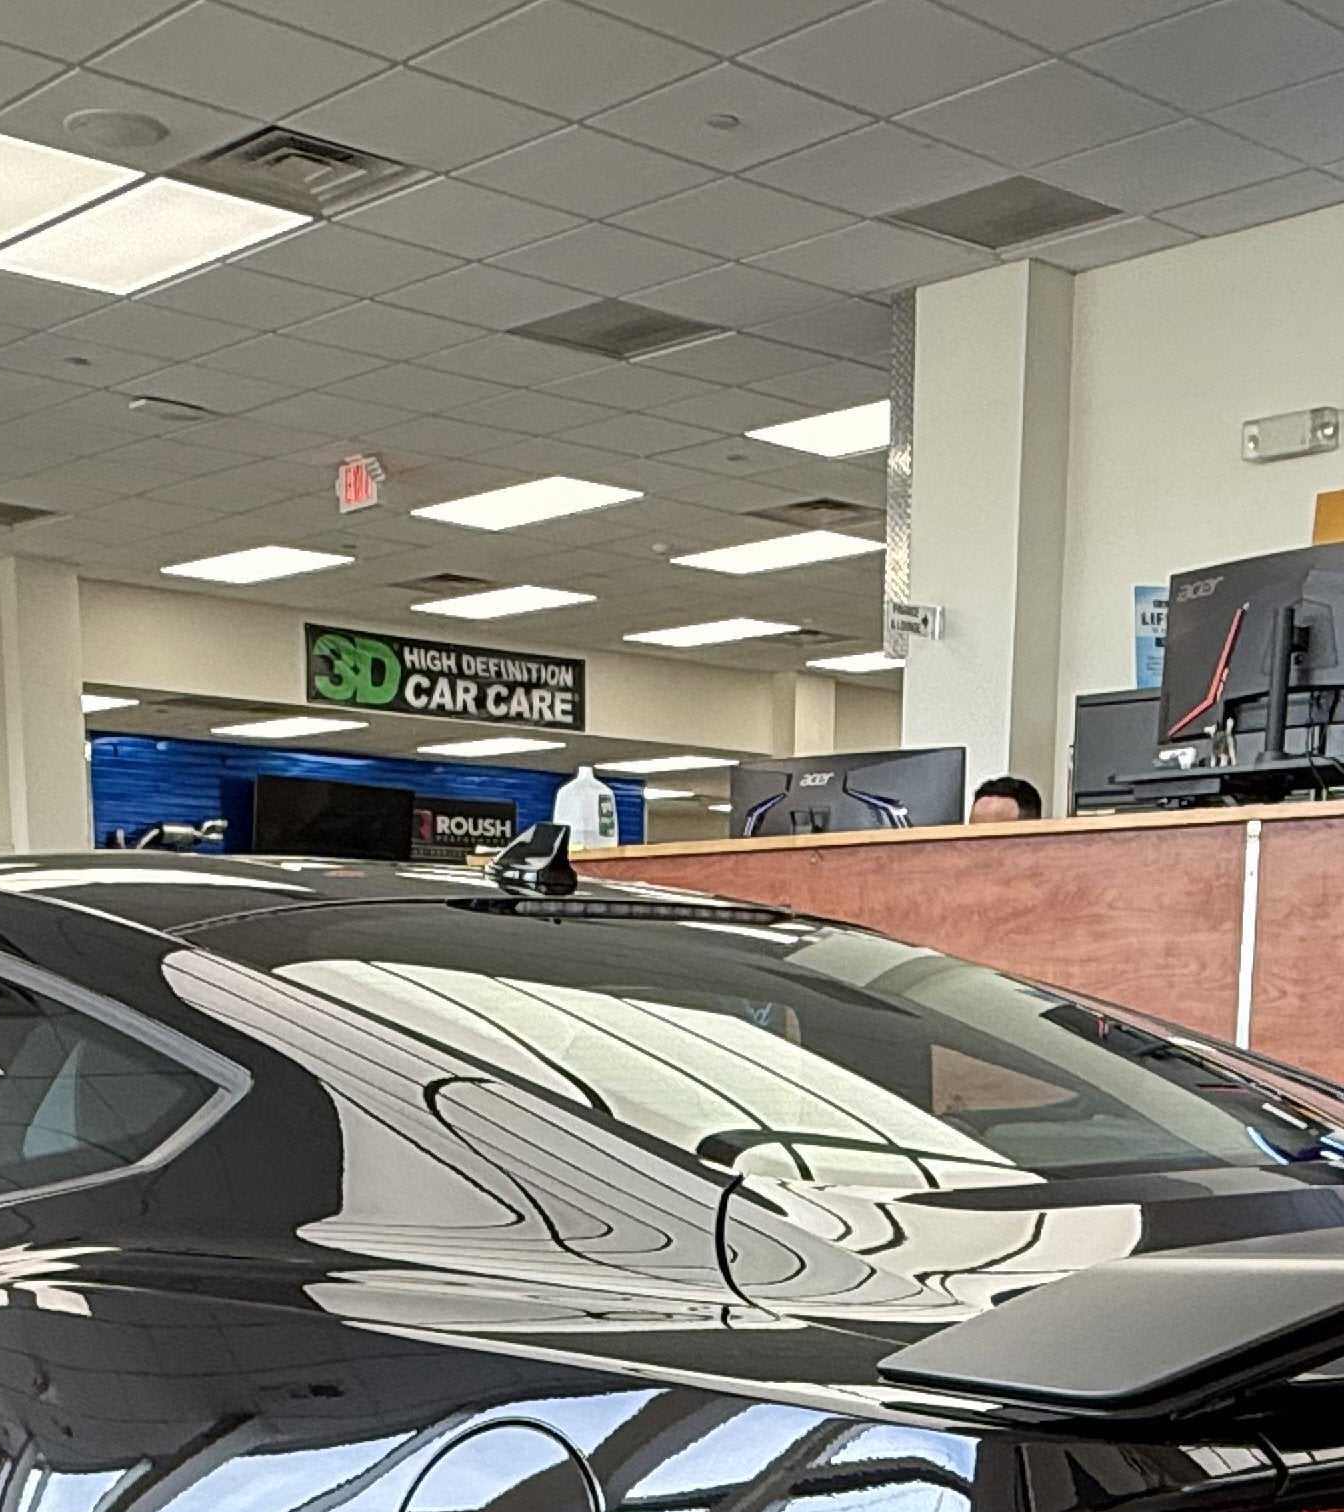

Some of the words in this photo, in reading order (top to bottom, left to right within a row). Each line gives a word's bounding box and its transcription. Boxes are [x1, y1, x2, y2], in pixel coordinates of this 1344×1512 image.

[1140, 612, 1168, 626] LIF
[313, 634, 402, 705] 3D
[402, 646, 458, 674] HIGH
[462, 653, 574, 688] DEFINITION
[404, 674, 478, 715] CAR
[485, 683, 574, 724] CARE
[799, 772, 835, 788] acer
[436, 815, 512, 838] ROUSH
